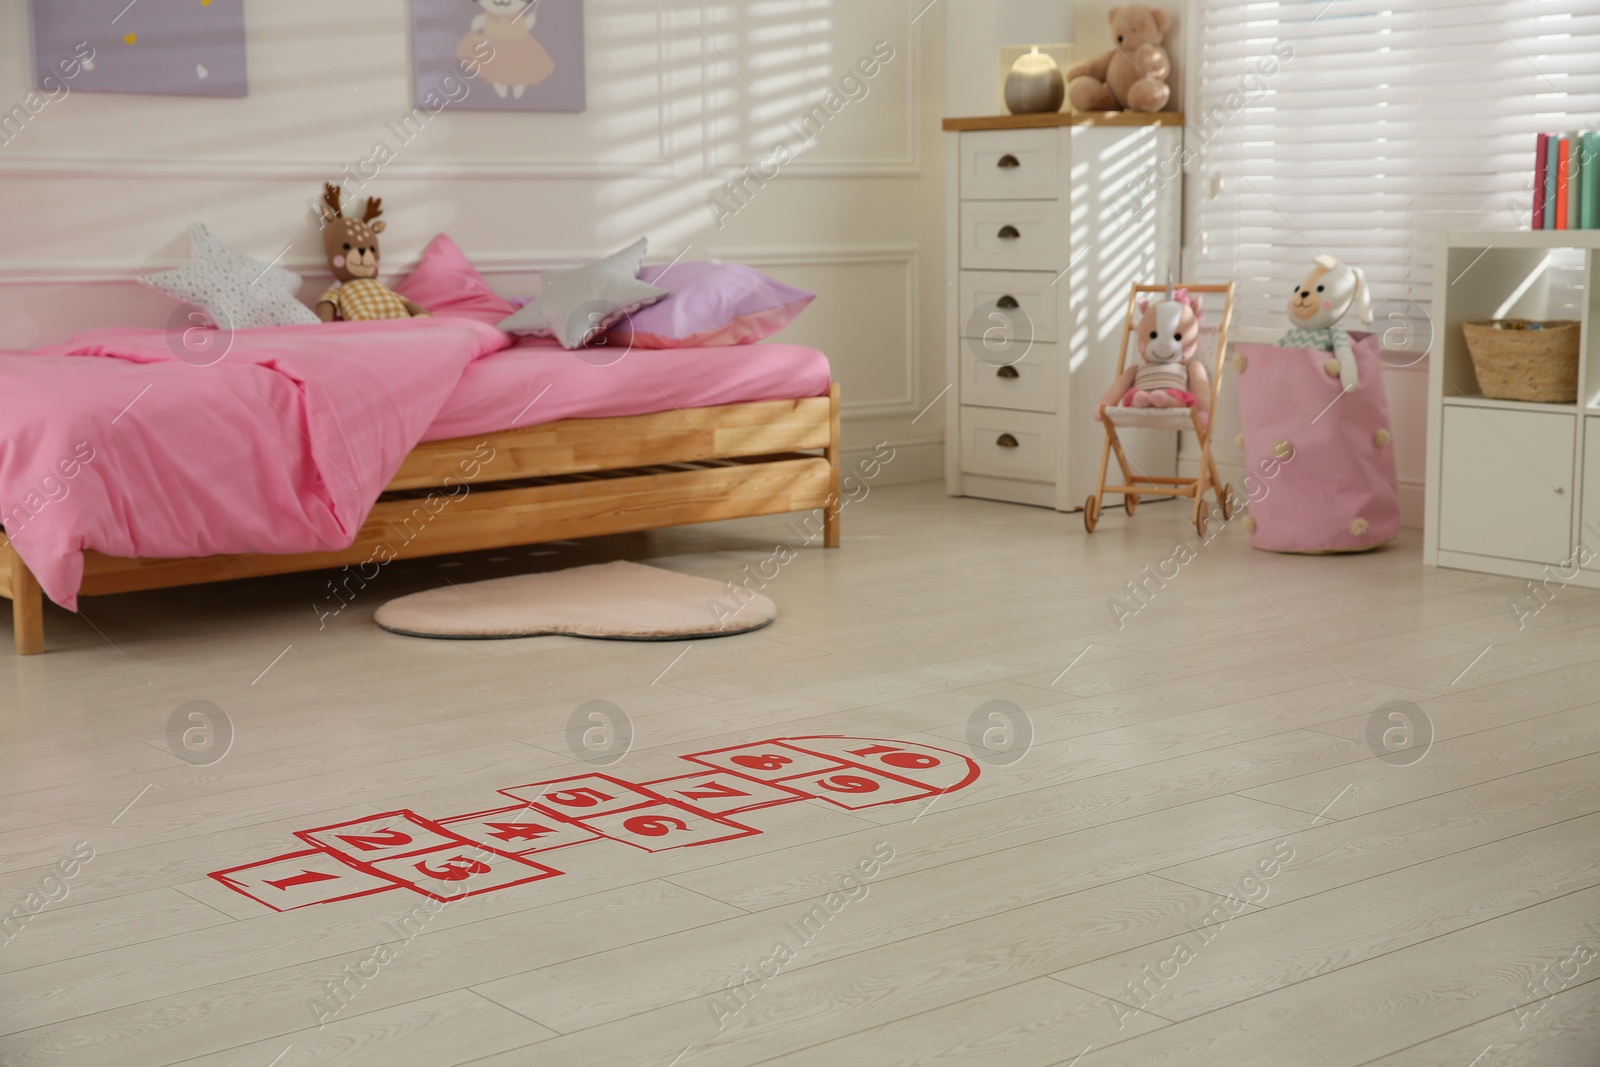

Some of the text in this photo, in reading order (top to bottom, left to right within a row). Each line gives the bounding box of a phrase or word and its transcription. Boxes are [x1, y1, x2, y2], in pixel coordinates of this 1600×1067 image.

[730, 754, 793, 770] 8
[843, 743, 941, 769] 10
[674, 781, 753, 801] 7
[812, 775, 880, 793] 9
[542, 787, 618, 807] 5
[483, 822, 560, 842] 4
[623, 815, 693, 837] 6
[334, 827, 413, 851] 2
[411, 855, 492, 881] 3
[261, 869, 342, 891] 1
